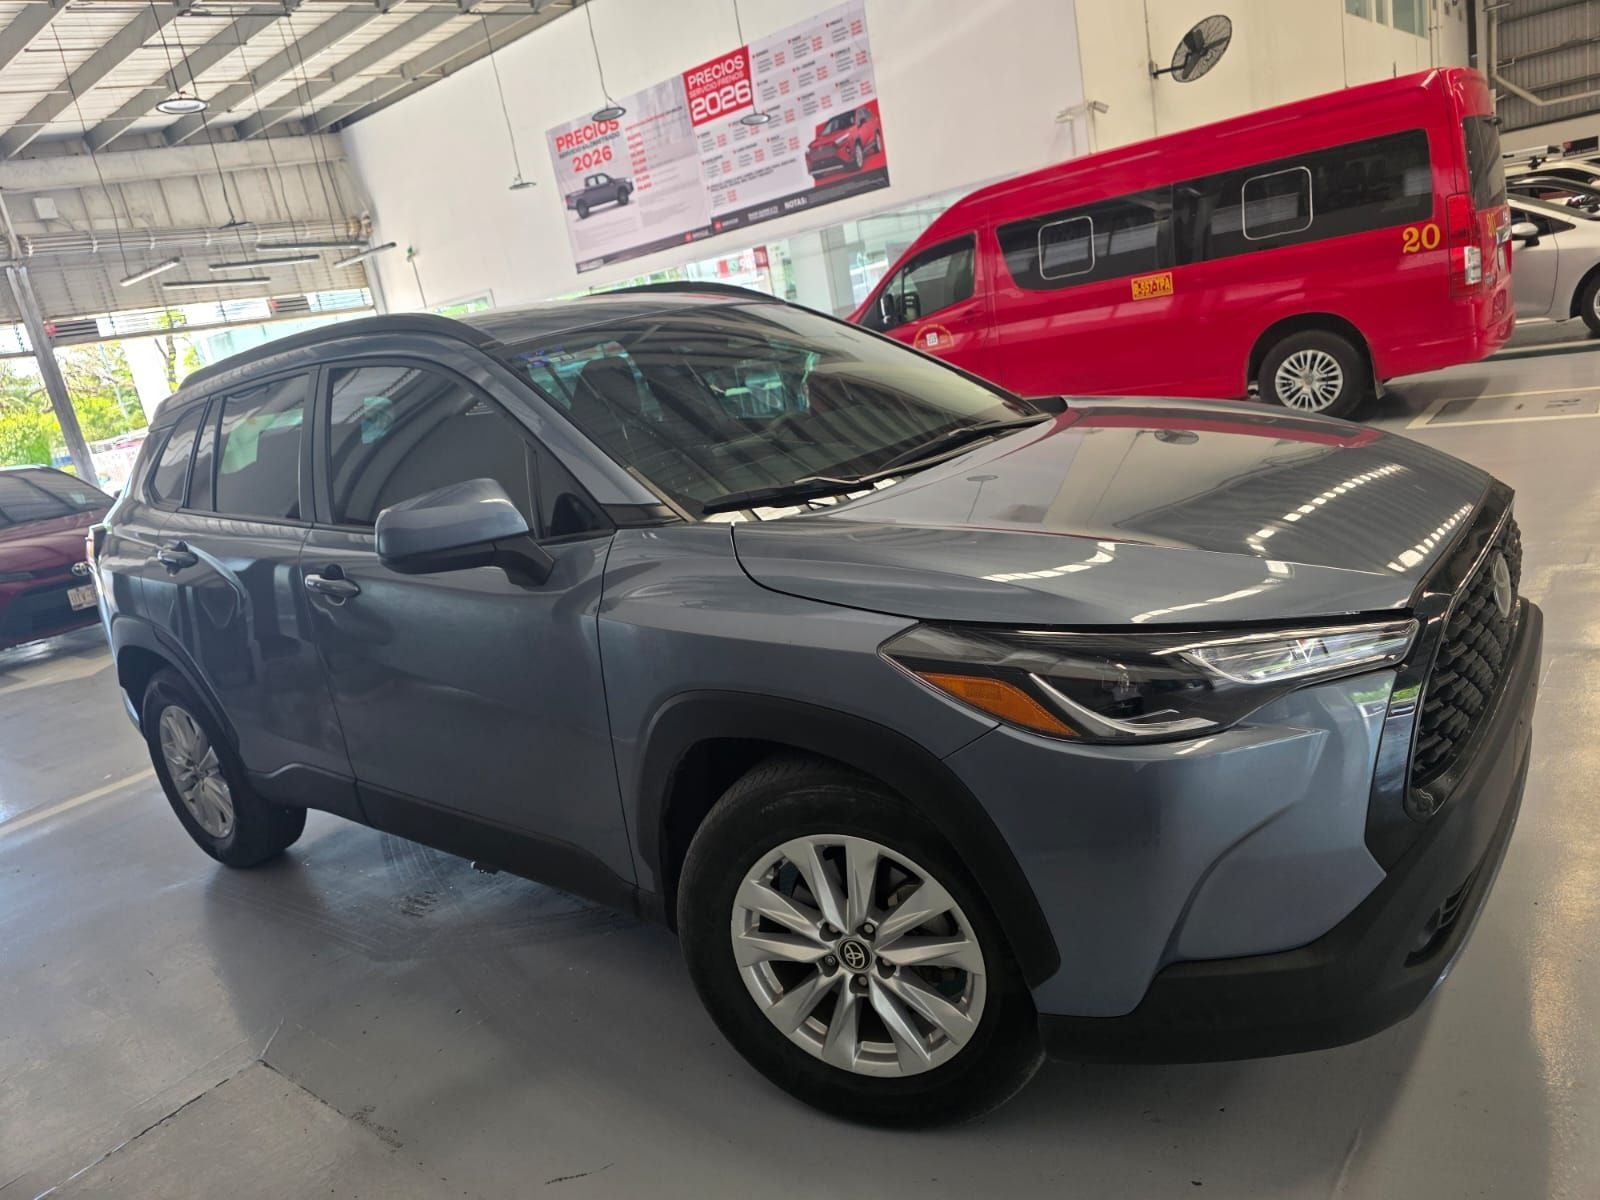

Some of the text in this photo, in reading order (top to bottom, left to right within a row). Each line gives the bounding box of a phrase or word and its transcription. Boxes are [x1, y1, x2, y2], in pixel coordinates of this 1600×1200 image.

[688, 55, 744, 89] PRECIOS
[691, 79, 751, 121] 2026
[556, 120, 619, 152] PRECIOS
[573, 145, 612, 172] 2026
[1403, 223, 1440, 254] 20
